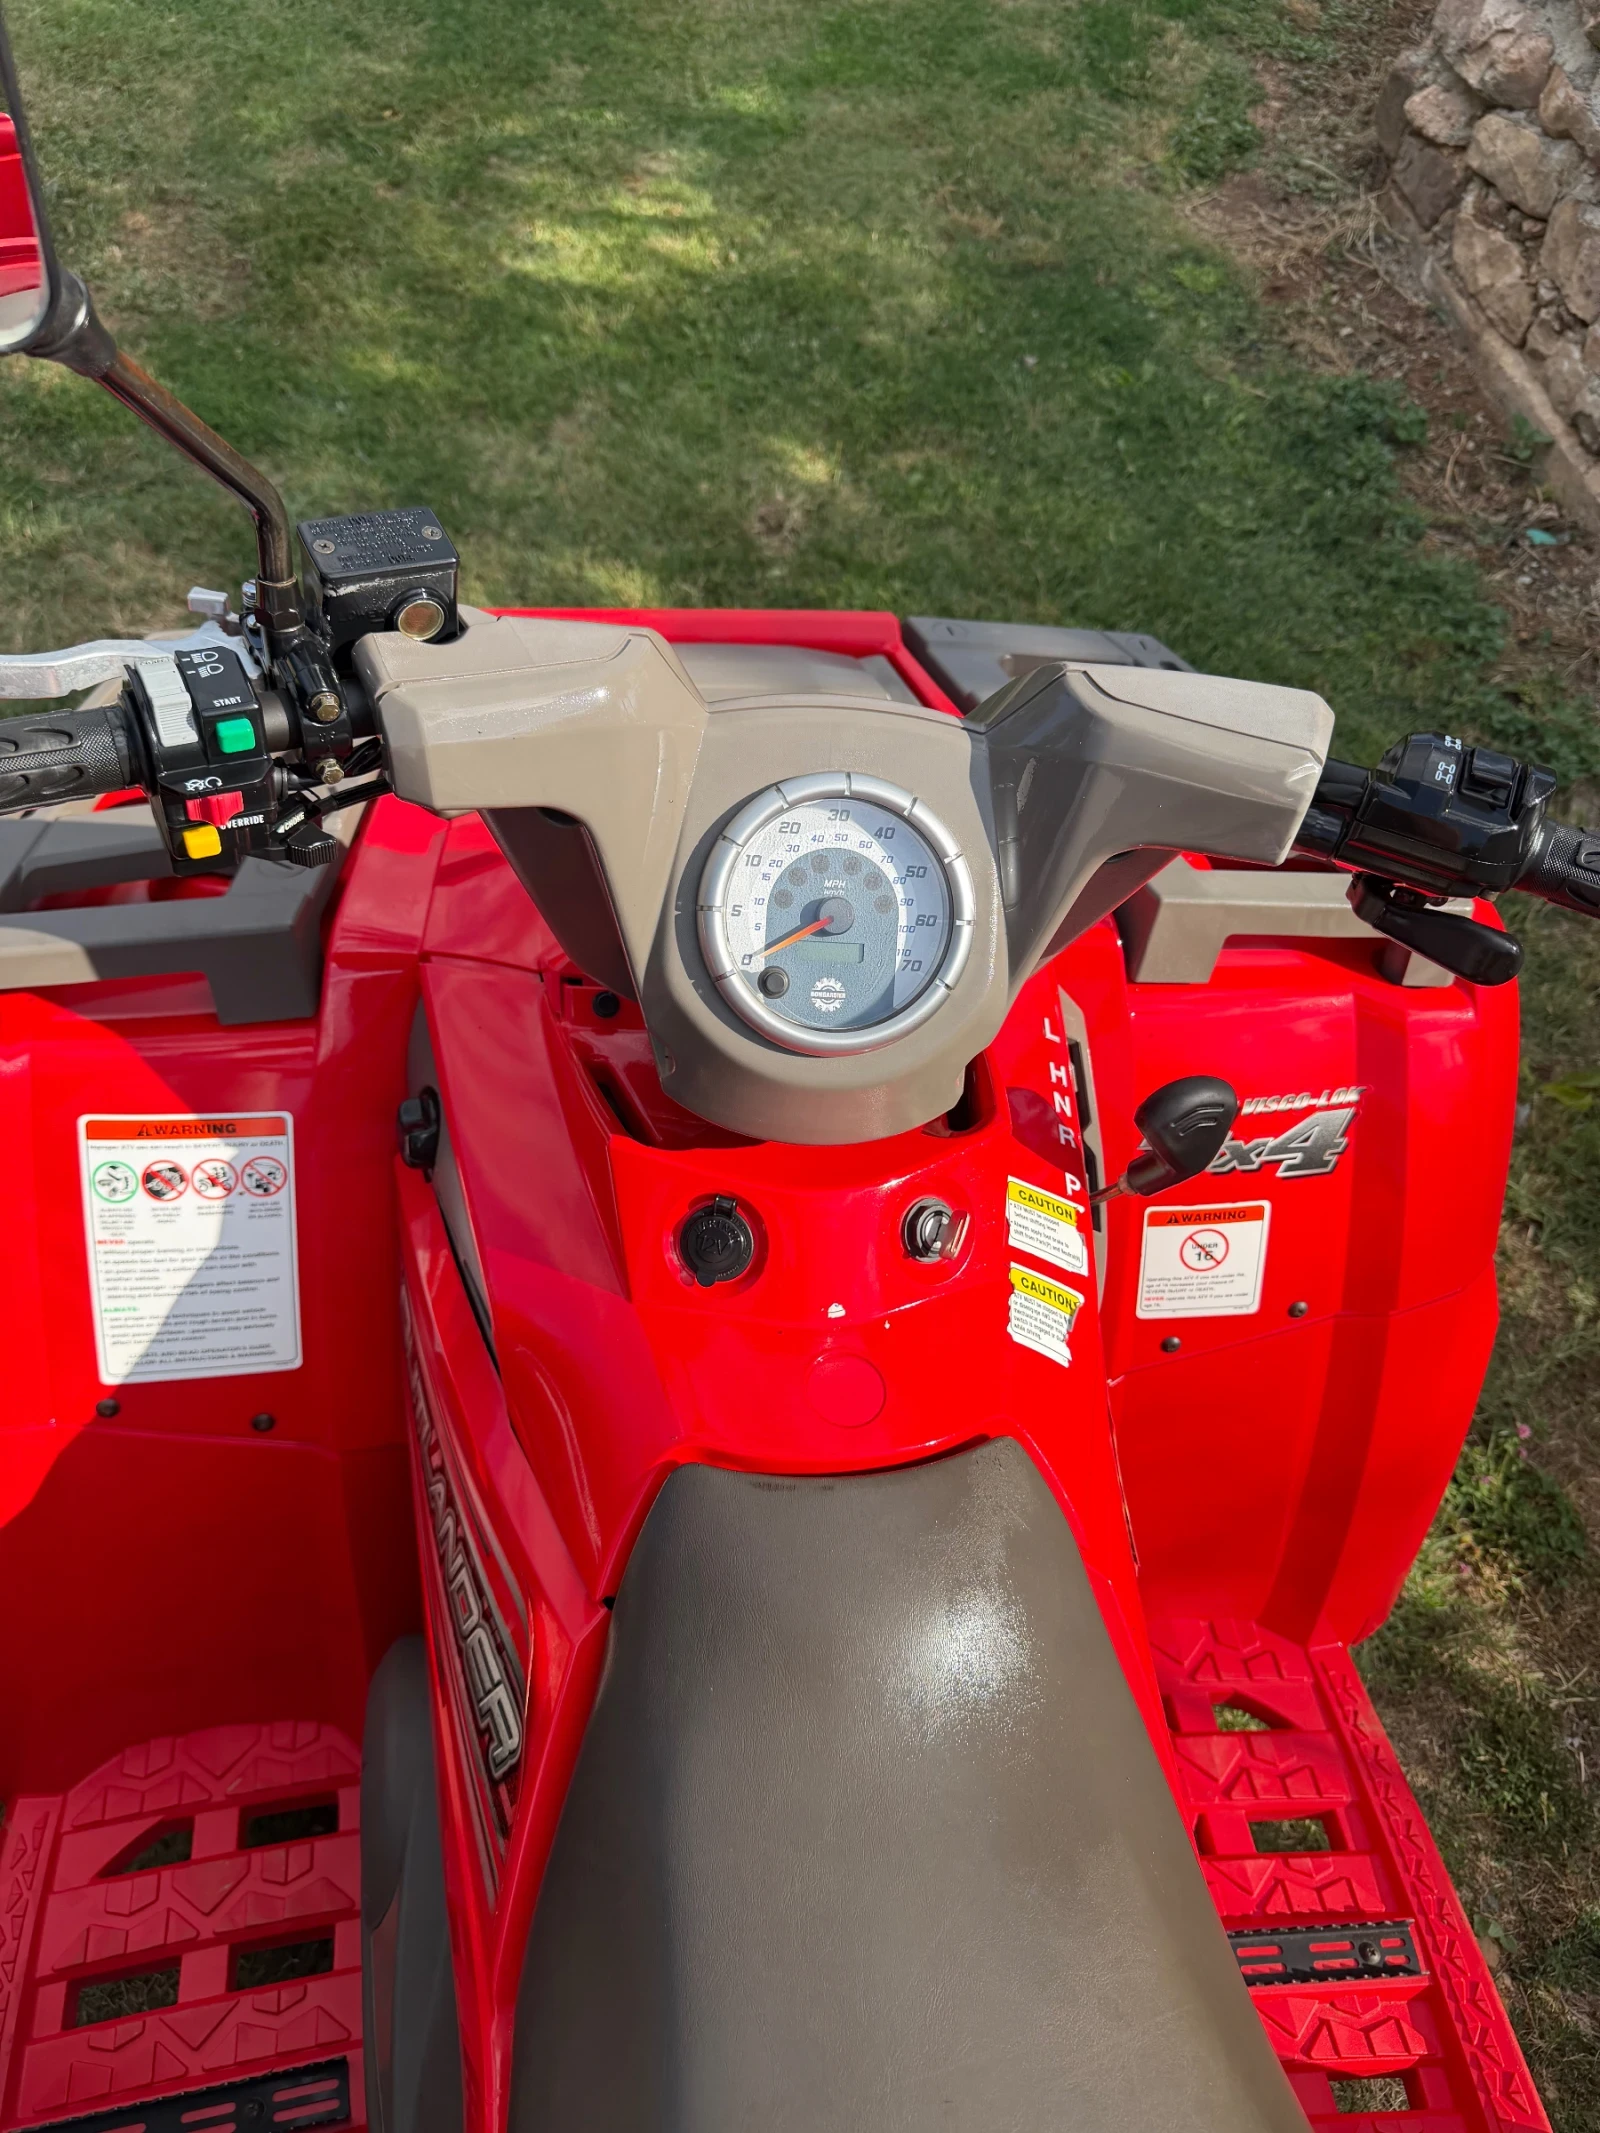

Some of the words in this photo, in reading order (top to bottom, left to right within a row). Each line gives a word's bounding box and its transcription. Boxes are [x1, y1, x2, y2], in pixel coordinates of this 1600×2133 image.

[212, 696, 242, 708] START
[284, 812, 305, 830] CHOKE
[827, 808, 851, 822] 30
[778, 821, 802, 834] 20
[874, 826, 896, 840] 40
[810, 834, 825, 843] 40
[834, 833, 849, 842] 50
[785, 844, 801, 853] 30
[858, 840, 873, 849] 60
[744, 854, 762, 867] 10
[768, 859, 784, 868] 20
[880, 855, 894, 864] 70
[761, 872, 772, 881] 15
[904, 865, 928, 879] 50
[823, 880, 846, 889] MPH
[892, 876, 907, 885] 80
[753, 897, 765, 906] 10
[899, 898, 914, 907] 90
[731, 904, 743, 917] 5
[754, 922, 762, 931] 5
[915, 914, 938, 927] 60
[898, 925, 916, 934] 100
[896, 949, 912, 957] 110
[741, 954, 753, 966] 0
[901, 960, 923, 972] 70
[1043, 1016, 1061, 1044] L
[1048, 1062, 1068, 1088] H
[1052, 1090, 1073, 1118] N
[1240, 1085, 1367, 1116] VISCO-LOK
[154, 1124, 237, 1135] WARNING
[1058, 1123, 1077, 1149] R
[1137, 1106, 1357, 1178] x4
[1064, 1172, 1082, 1196] P
[1018, 1190, 1073, 1220] CAUTION
[1181, 1210, 1247, 1223] WARNING
[1194, 1250, 1214, 1262] 16
[1020, 1276, 1074, 1310] CAUTION
